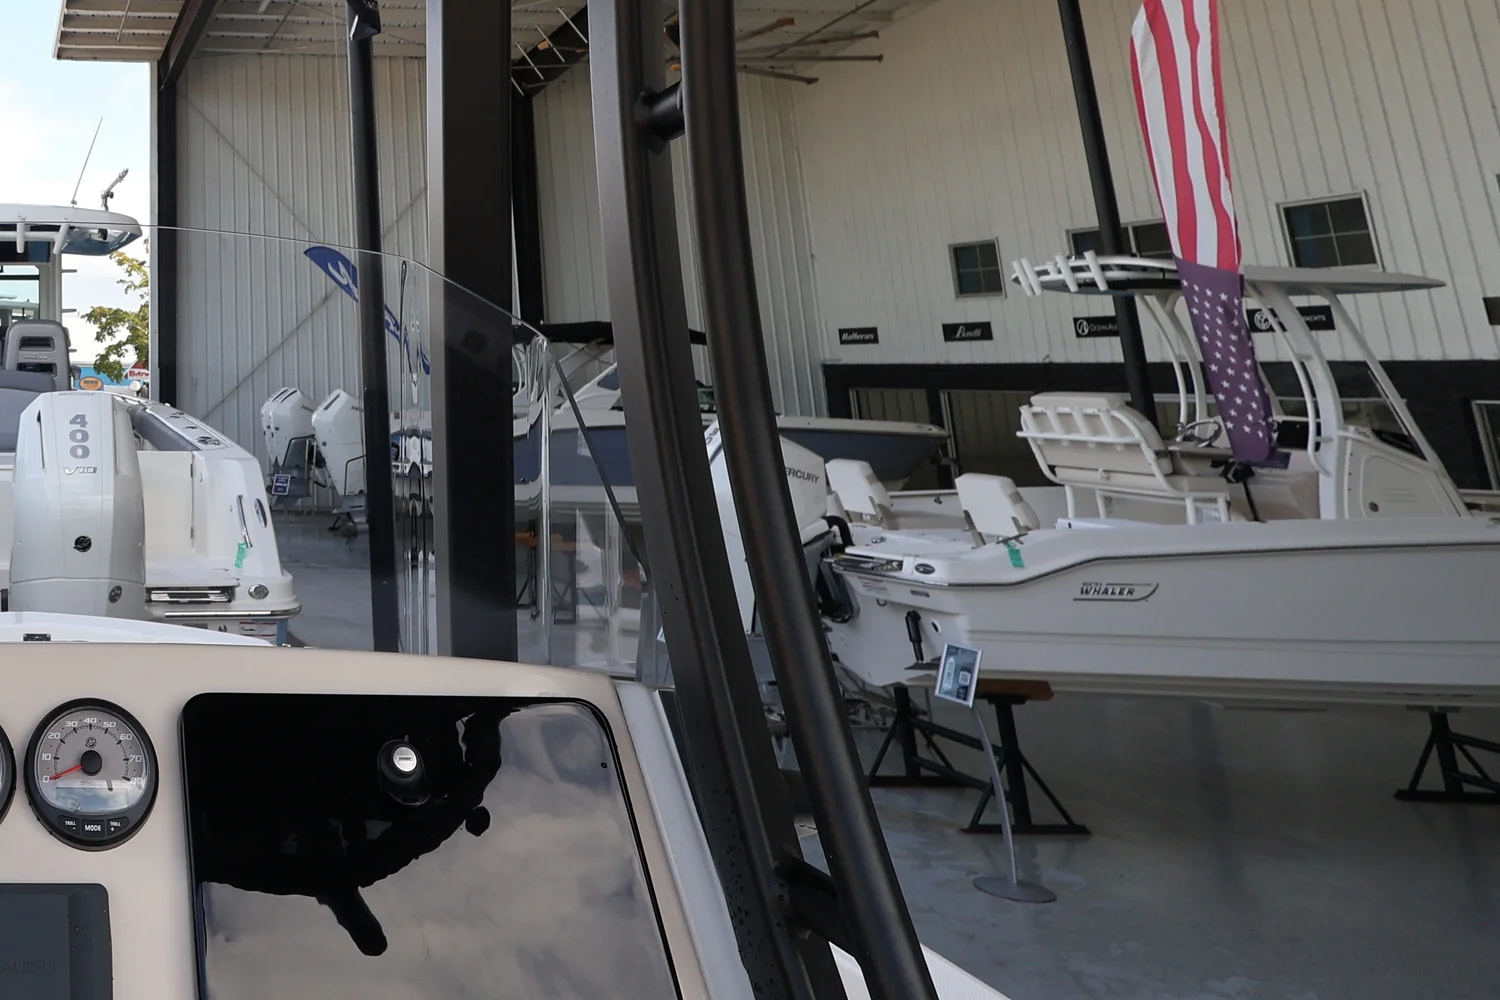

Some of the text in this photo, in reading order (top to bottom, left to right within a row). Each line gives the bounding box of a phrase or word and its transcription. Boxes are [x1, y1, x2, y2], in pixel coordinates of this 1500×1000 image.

[69, 413, 90, 460] 400
[785, 466, 820, 484] ERCURY
[1080, 587, 1135, 596] WHALER
[65, 720, 78, 728] 30
[120, 733, 133, 741] 60
[41, 753, 52, 761] 10
[129, 754, 142, 763] 70
[84, 824, 102, 832] MODE
[1, 960, 55, 975] AUDIO
